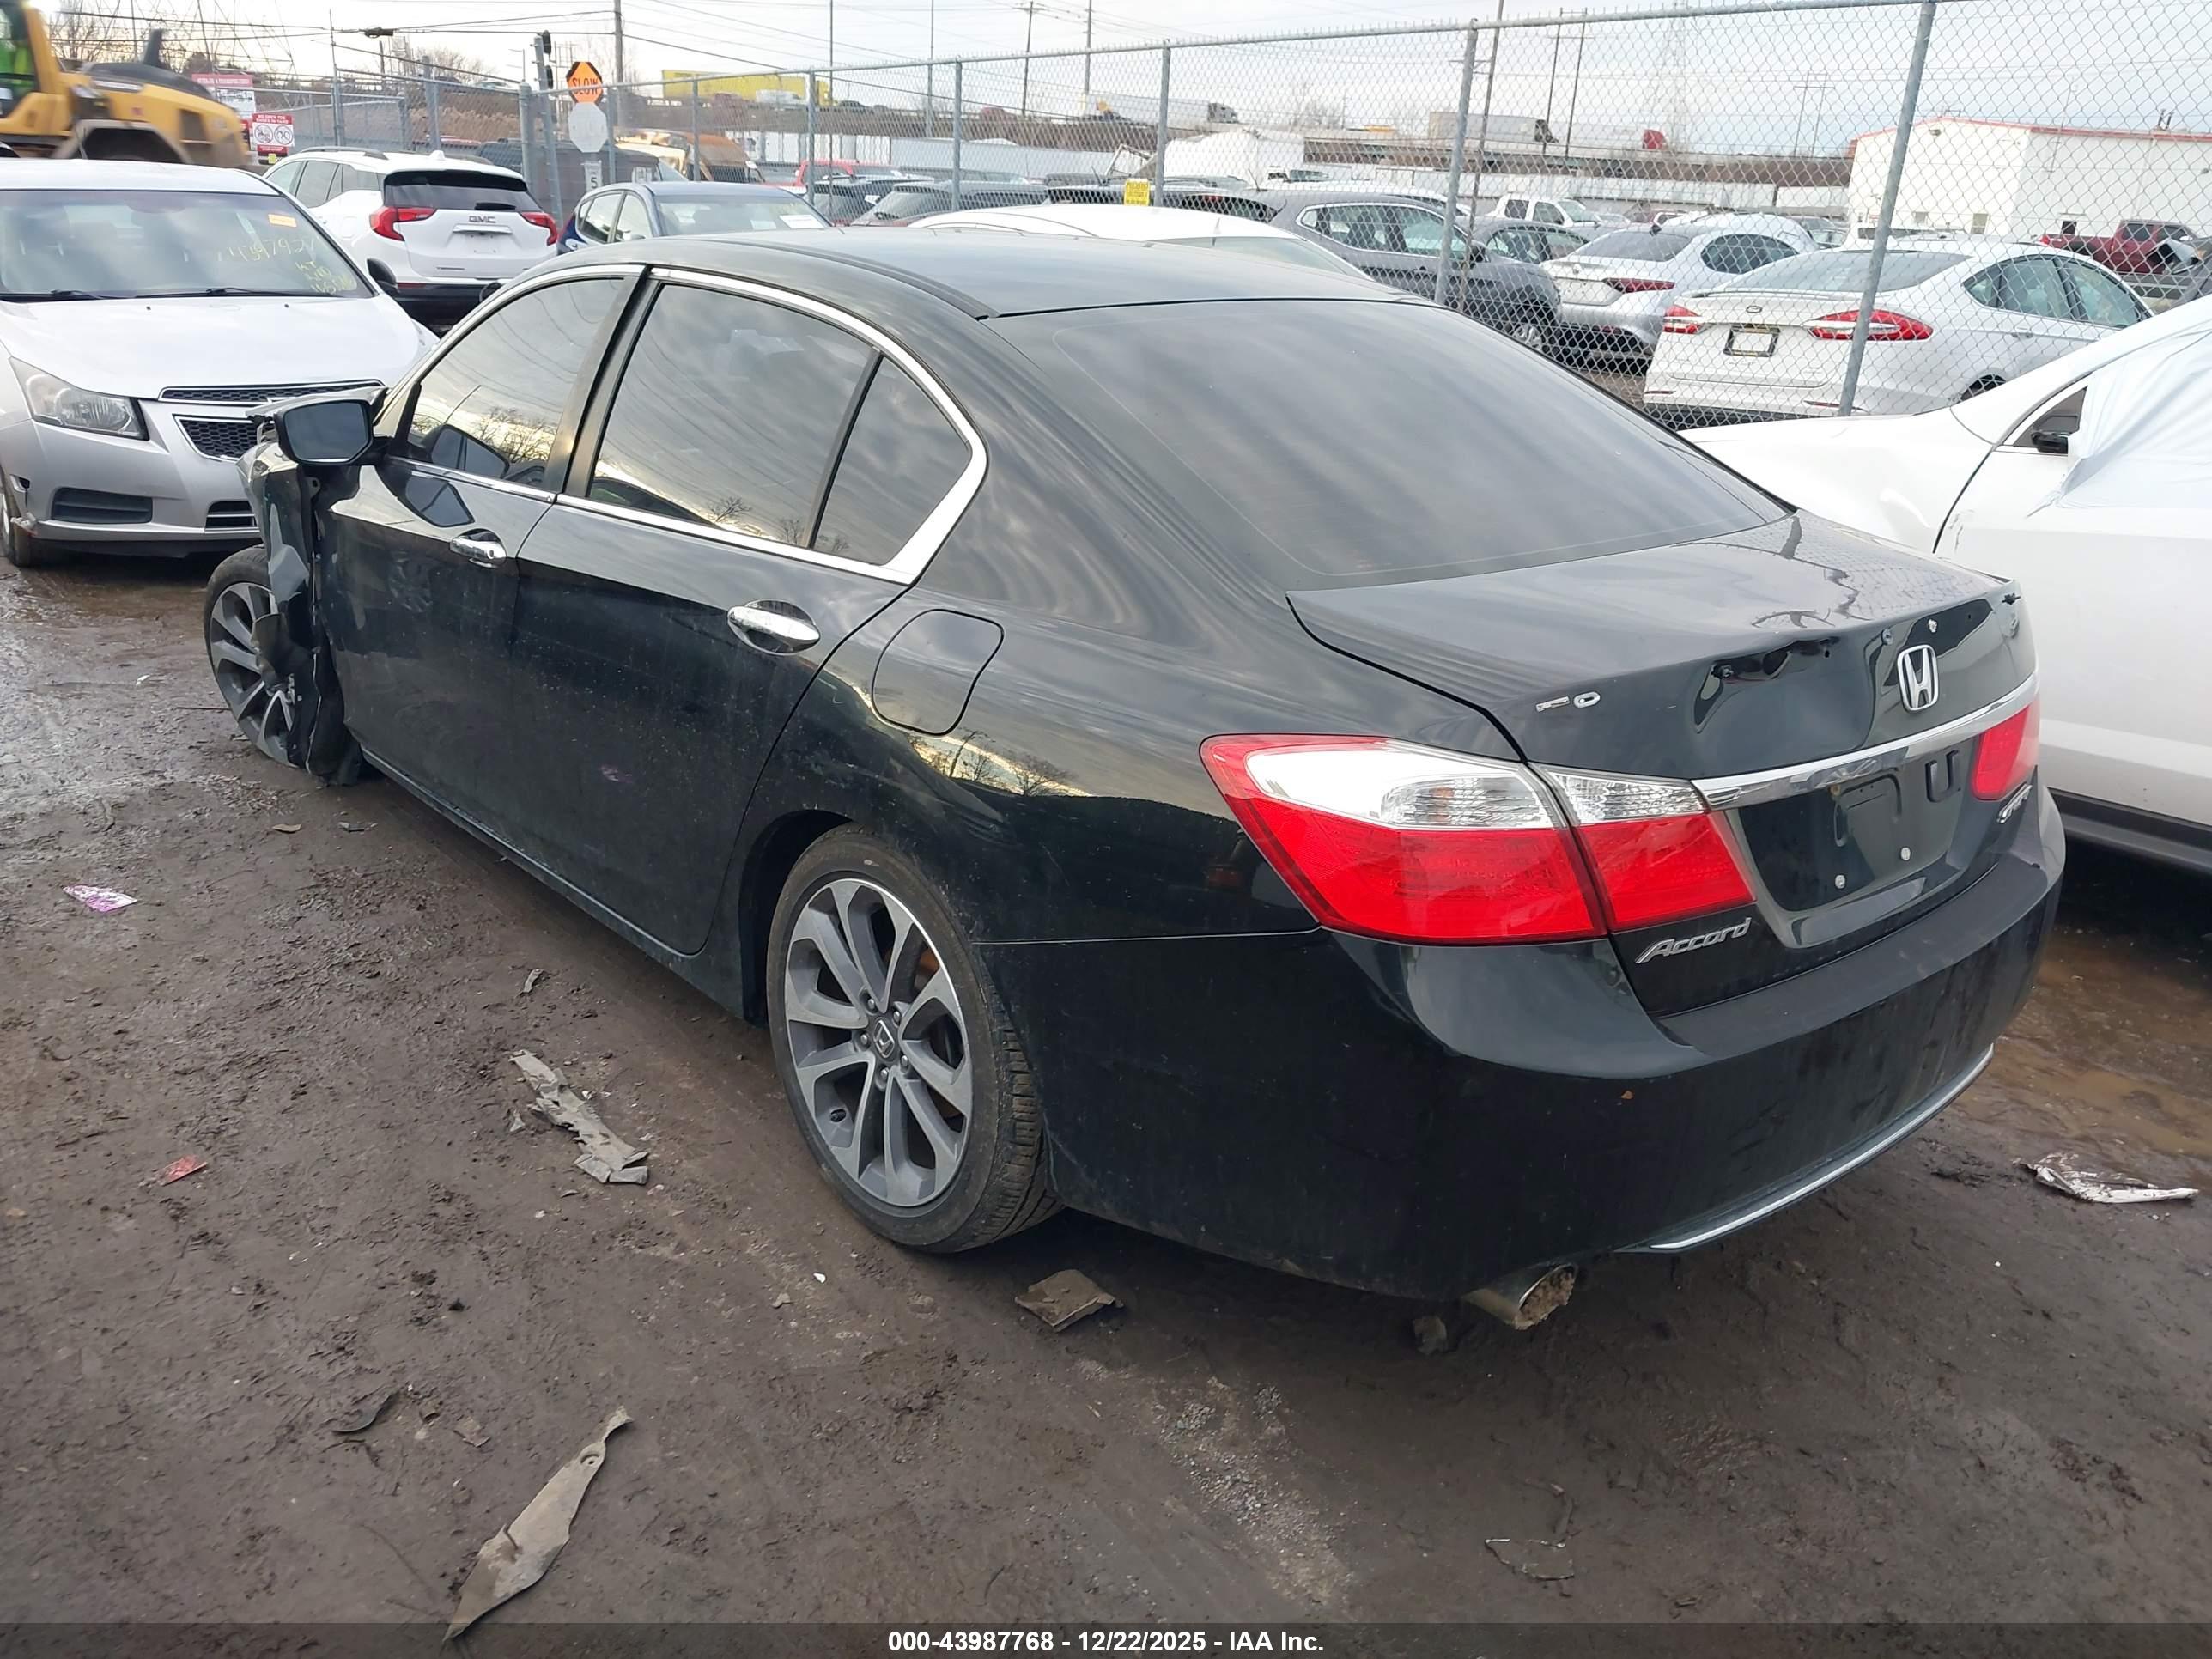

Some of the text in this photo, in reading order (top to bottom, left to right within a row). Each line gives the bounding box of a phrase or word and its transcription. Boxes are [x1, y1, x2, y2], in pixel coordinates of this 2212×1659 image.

[572, 77, 599, 96] SLOW
[590, 176, 599, 189] 5
[1635, 916, 1752, 964] Accord
